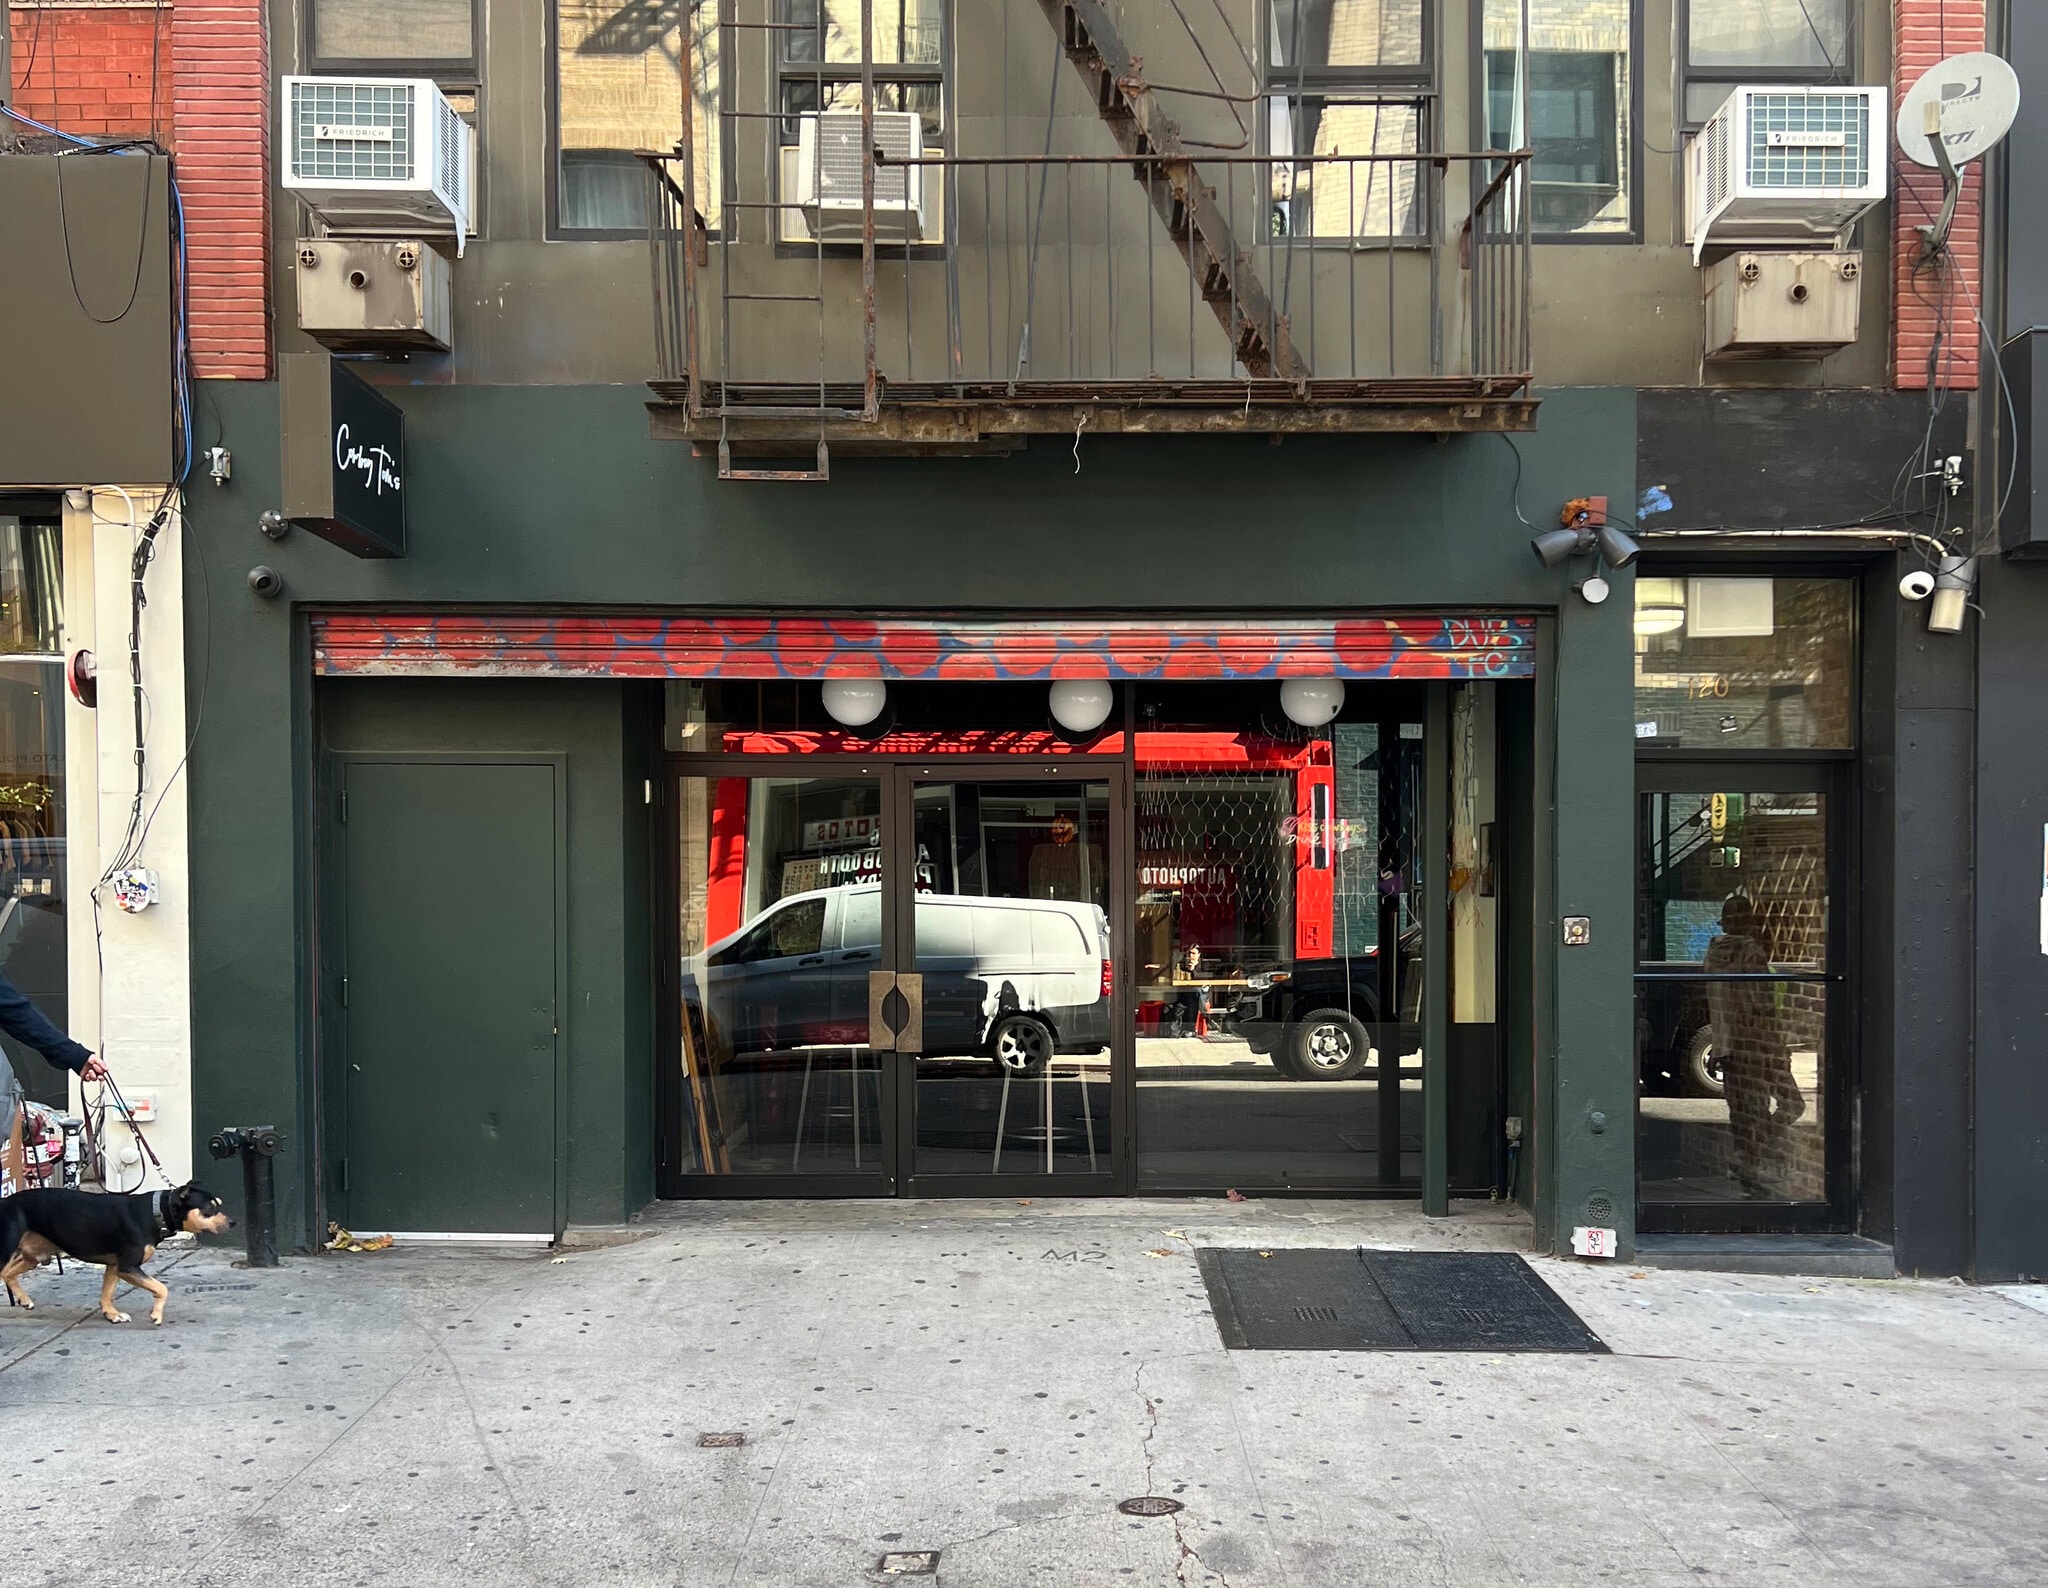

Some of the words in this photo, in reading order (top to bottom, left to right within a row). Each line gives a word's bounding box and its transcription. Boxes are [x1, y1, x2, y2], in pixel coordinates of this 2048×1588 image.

[332, 128, 384, 136] FRIEDRICH
[1786, 135, 1837, 143] FRIEDRICH
[1688, 675, 1729, 700] 120
